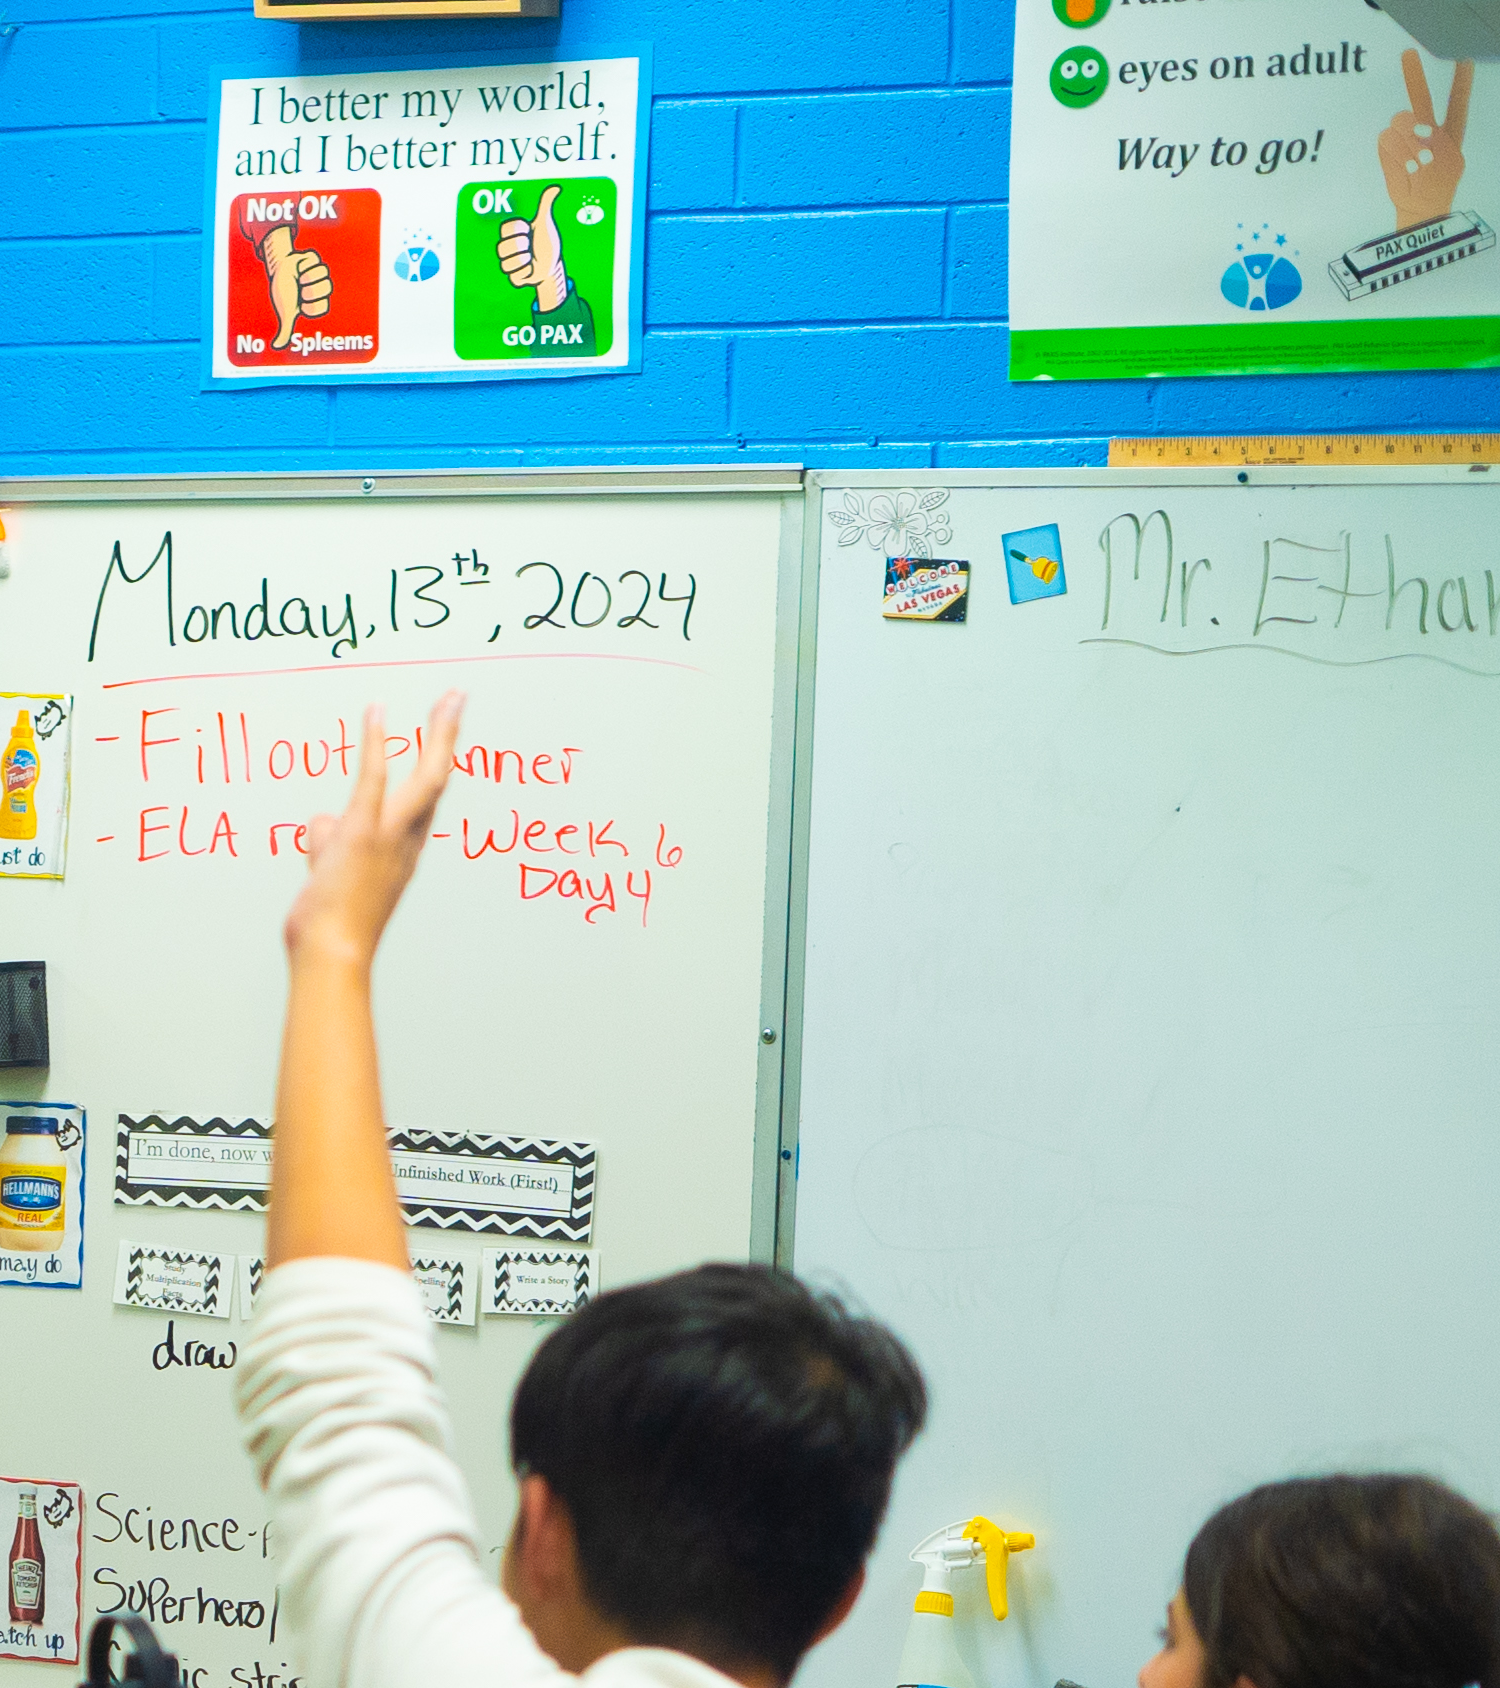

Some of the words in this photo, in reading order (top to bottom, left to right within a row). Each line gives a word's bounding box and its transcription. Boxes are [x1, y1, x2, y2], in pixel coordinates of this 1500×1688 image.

[1118, 57, 1198, 92] eyes
[1210, 53, 1253, 80] on
[1266, 41, 1367, 77] adult
[250, 88, 264, 125] I
[279, 87, 388, 123] better
[402, 89, 463, 127] my
[478, 71, 605, 114] world,
[235, 137, 302, 177] and
[318, 135, 332, 172] I
[347, 134, 457, 172] better
[470, 120, 616, 175] myself.
[1116, 137, 1199, 178] Way
[1210, 136, 1247, 167] to
[1255, 130, 1324, 175] go!
[246, 198, 293, 223] Not
[298, 195, 338, 219] OK
[472, 189, 513, 214] OK
[1376, 239, 1402, 261] PAX
[1406, 224, 1445, 250] Quiet
[237, 335, 265, 354] No
[291, 333, 373, 355] Spleems
[502, 327, 535, 347] GO
[540, 324, 582, 344] PAX
[886, 562, 959, 594] WELCOME
[1099, 509, 1220, 630] Mr.
[88, 531, 377, 663] Monday,
[515, 561, 699, 641] 2024
[896, 599, 917, 612] LAS
[921, 584, 960, 603] VEGAS
[140, 708, 251, 786] Fill
[269, 721, 357, 780] out
[29, 847, 45, 866] do
[521, 863, 615, 925] Day
[625, 871, 652, 926] 4
[135, 1138, 163, 1158] I'm
[169, 1140, 216, 1162] done,
[220, 1146, 257, 1161] now
[3, 1181, 60, 1199] HELLMANN'S
[469, 1168, 506, 1187] Work
[510, 1173, 559, 1195] (First!)
[45, 1254, 62, 1273] do
[516, 1275, 538, 1285] Write
[548, 1275, 570, 1288] Story
[152, 1320, 237, 1370] draw
[45, 1634, 64, 1657] up
